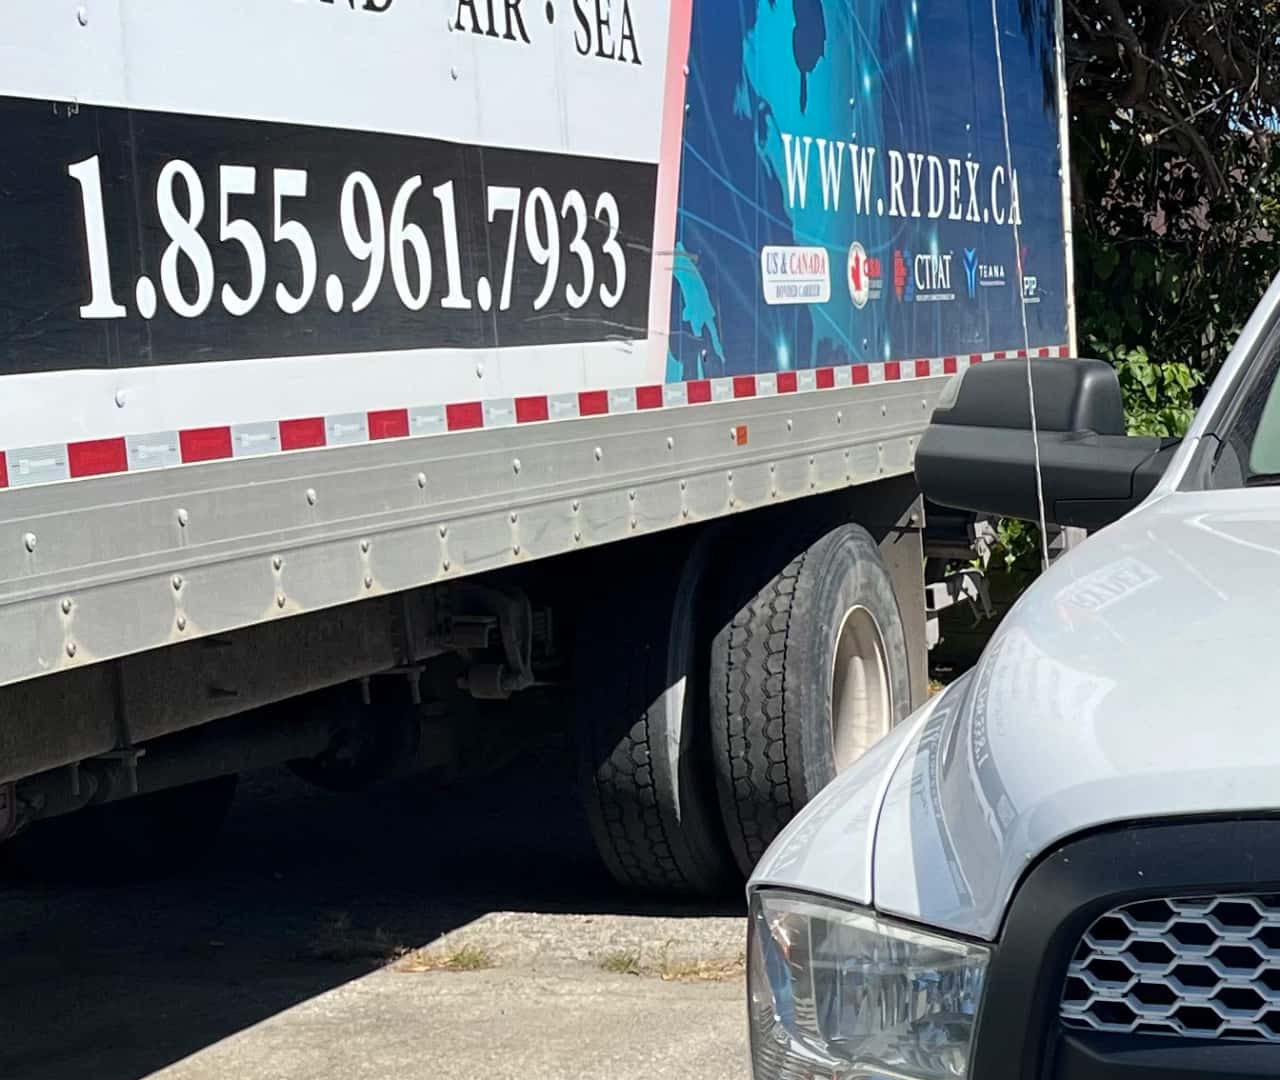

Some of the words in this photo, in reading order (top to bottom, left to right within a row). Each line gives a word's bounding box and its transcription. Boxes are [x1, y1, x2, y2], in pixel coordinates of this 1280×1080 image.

[454, 0, 531, 43] AIR
[574, 0, 642, 65] SEA
[781, 133, 1022, 225] WWW.RYDEX.CA
[68, 154, 627, 319] 1.855.961.7933
[766, 252, 778, 274] US
[789, 252, 826, 275] CANADA
